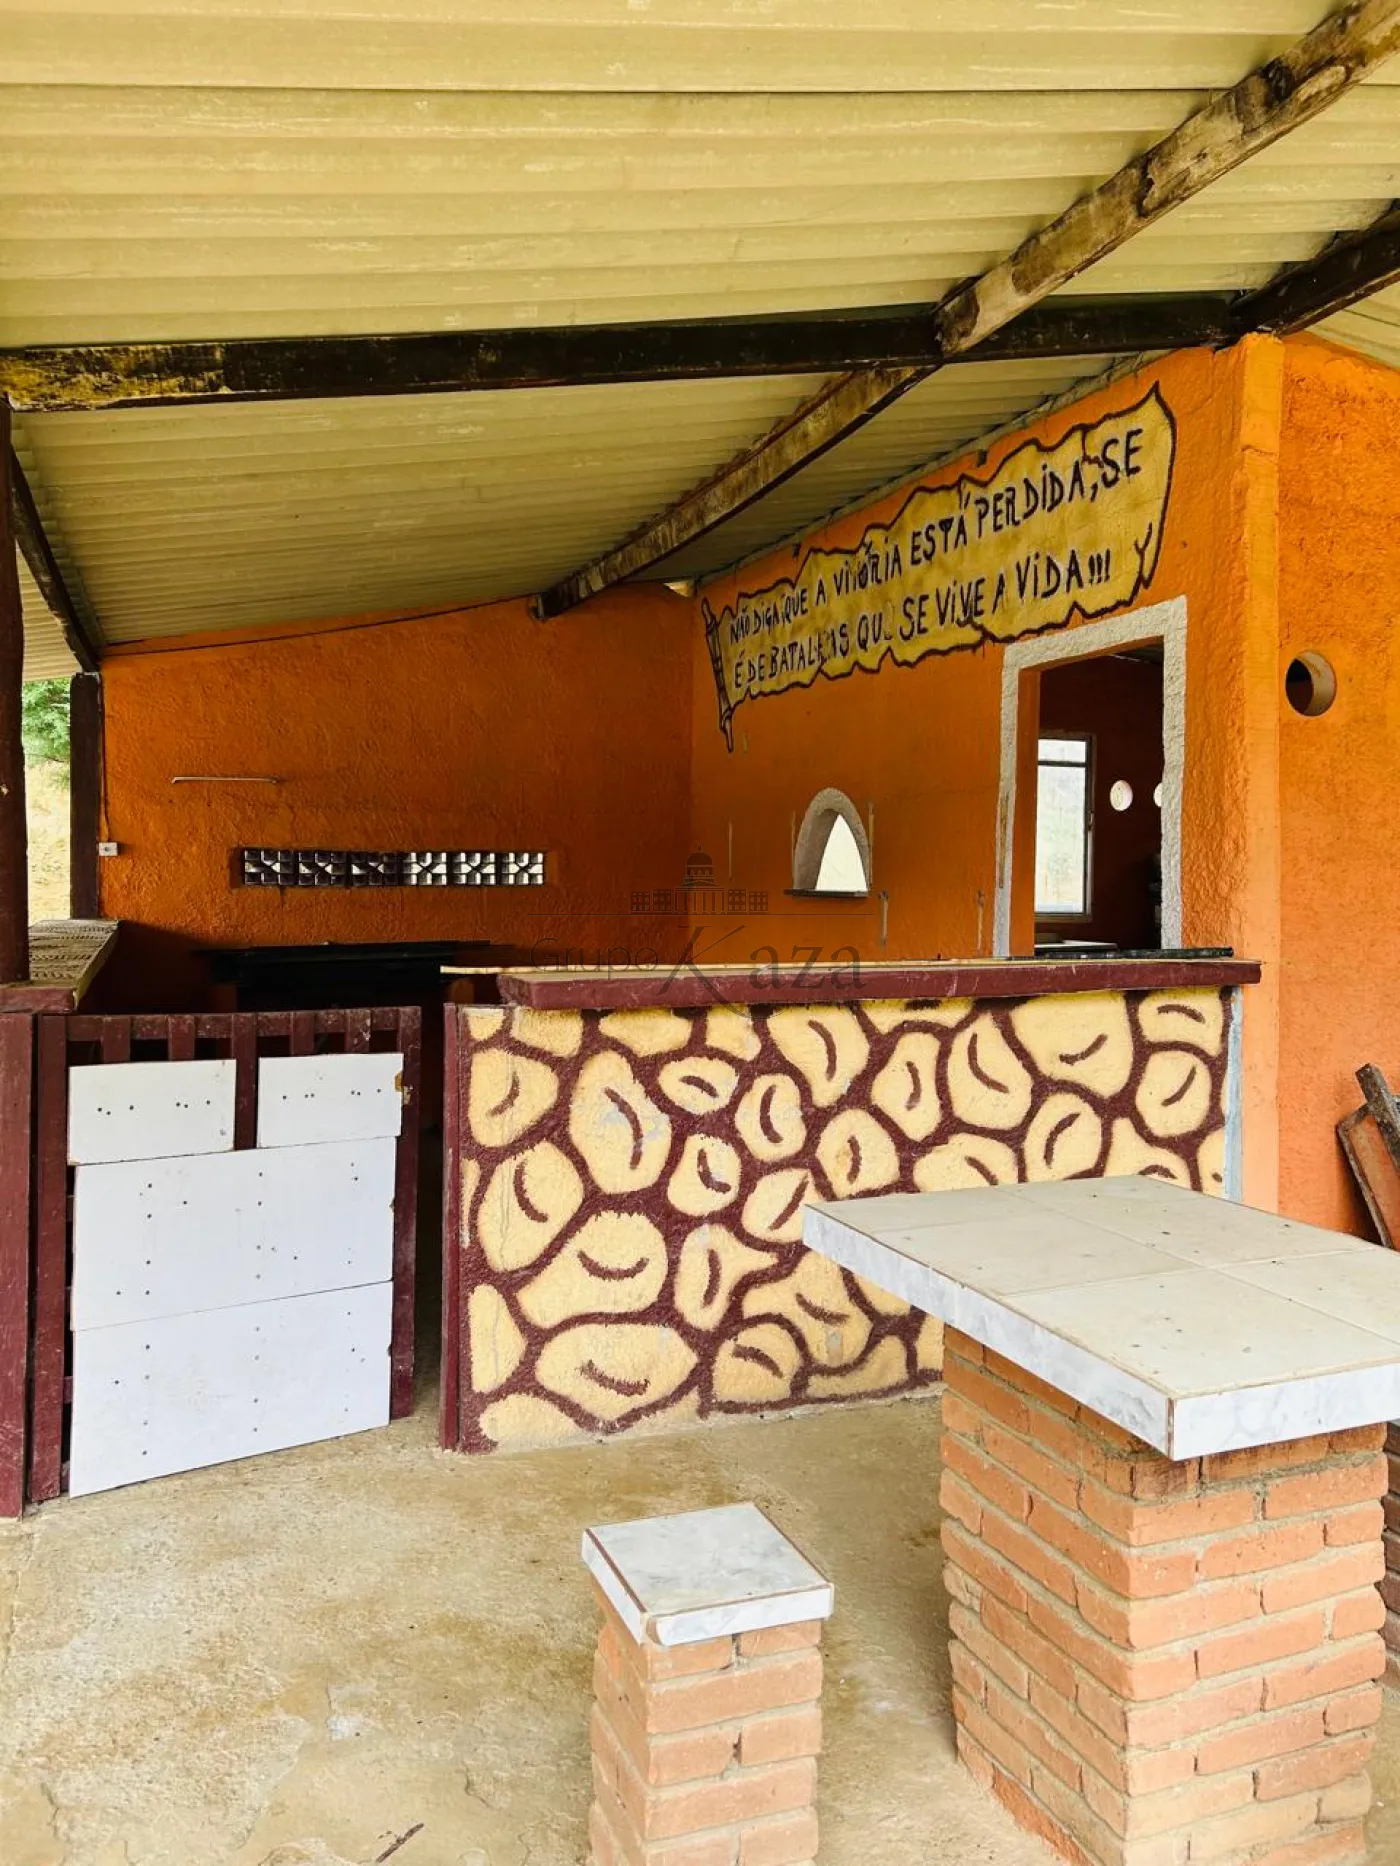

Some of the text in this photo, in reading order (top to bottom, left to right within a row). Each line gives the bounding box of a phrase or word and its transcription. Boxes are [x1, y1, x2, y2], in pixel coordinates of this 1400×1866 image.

[815, 578, 827, 607] A
[1100, 428, 1144, 490] SE
[747, 653, 766, 684] DE
[857, 607, 894, 652] QU
[899, 593, 931, 642] SE
[992, 571, 1007, 614] A
